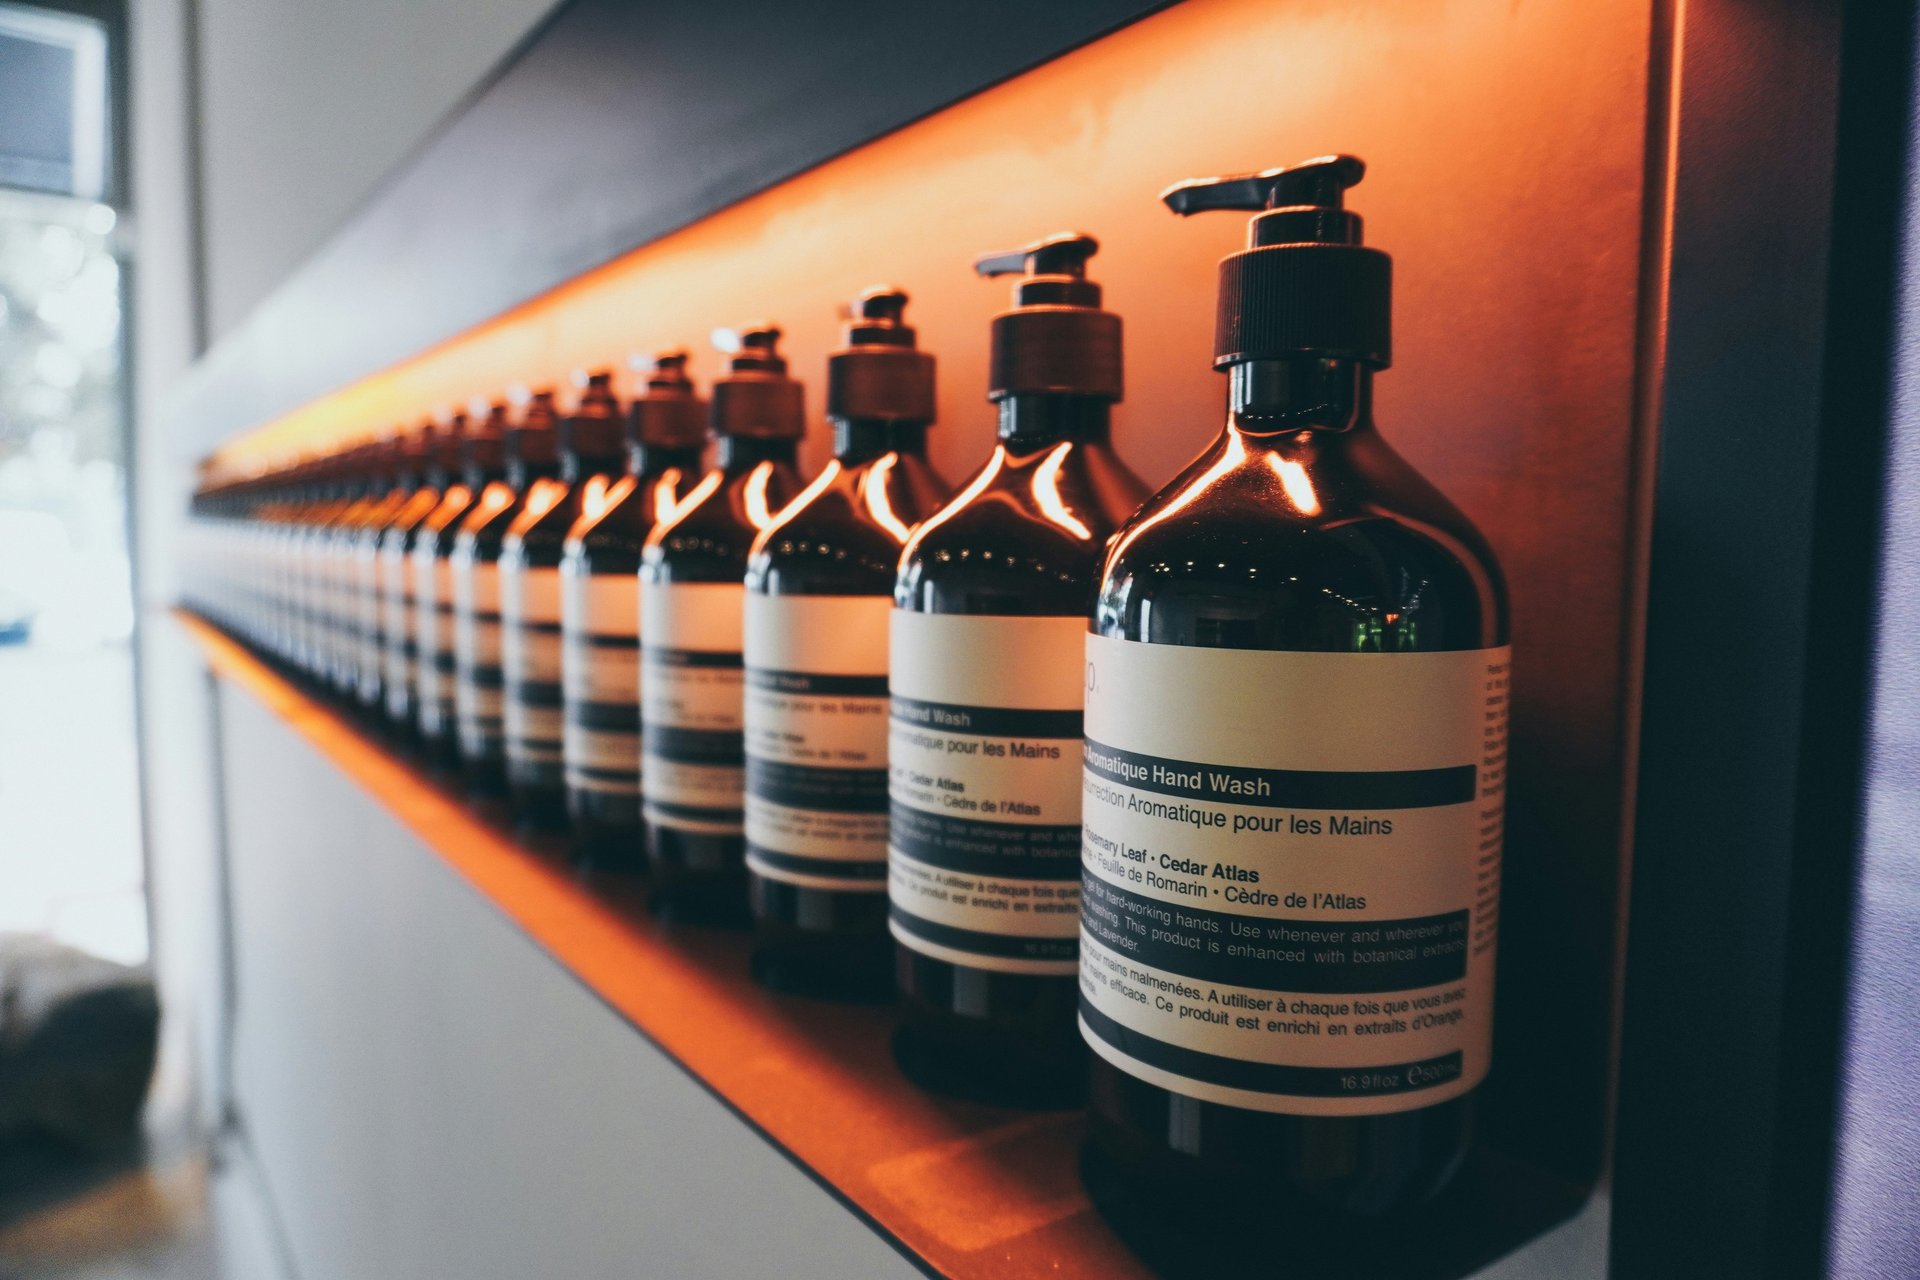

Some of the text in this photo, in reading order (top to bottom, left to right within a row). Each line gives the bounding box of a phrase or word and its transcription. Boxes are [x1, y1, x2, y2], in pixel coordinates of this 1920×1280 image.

[933, 709, 971, 728] Wash
[947, 739, 979, 754] pour
[983, 741, 1005, 756] les
[1010, 743, 1061, 759] Mains
[936, 777, 965, 793] Atlas
[1088, 746, 1149, 781] Aromatique
[1152, 765, 1203, 791] Hand
[1208, 772, 1272, 797] Wash
[1127, 793, 1227, 830] Aromatique
[1232, 813, 1285, 834] pour
[1289, 814, 1323, 836] les
[1328, 815, 1394, 836] Mains
[1120, 842, 1148, 864] Leaf
[1159, 853, 1209, 877] Cedar
[1211, 862, 1260, 884] Atlas
[1128, 865, 1144, 883] de
[1146, 870, 1208, 898] Romarin
[1224, 886, 1280, 908] Cèdre
[1284, 892, 1308, 909] de
[1312, 892, 1368, 911] l'Atlas
[1098, 922, 1140, 953] Lavender.
[1106, 889, 1172, 927] hard-working
[1175, 911, 1224, 934] hands.
[1229, 922, 1261, 939] Use
[1266, 927, 1347, 943] whenever
[1351, 929, 1380, 943] and
[1385, 923, 1445, 942] wherever
[1124, 915, 1148, 936] This
[1151, 928, 1202, 951] product
[1207, 941, 1221, 954] is
[1227, 944, 1306, 963] enhanced
[1313, 949, 1345, 964] with
[1352, 946, 1417, 964] botanical
[1103, 956, 1128, 978] mains
[1129, 969, 1205, 1001] malmenées.
[1207, 989, 1220, 1004] A
[1221, 994, 1272, 1012] utiliser
[1276, 999, 1287, 1014] à
[1291, 1001, 1350, 1018] chaque
[1352, 1000, 1380, 1016] fois
[1383, 999, 1410, 1016] que
[1412, 993, 1441, 1010] vous
[1110, 978, 1150, 1006] efficace.
[1155, 995, 1174, 1013] Ce
[1179, 1005, 1230, 1027] produit
[1236, 1016, 1260, 1031] est
[1267, 1020, 1320, 1036] enrichi
[1327, 1023, 1348, 1036] en
[1354, 1018, 1408, 1036] extraits
